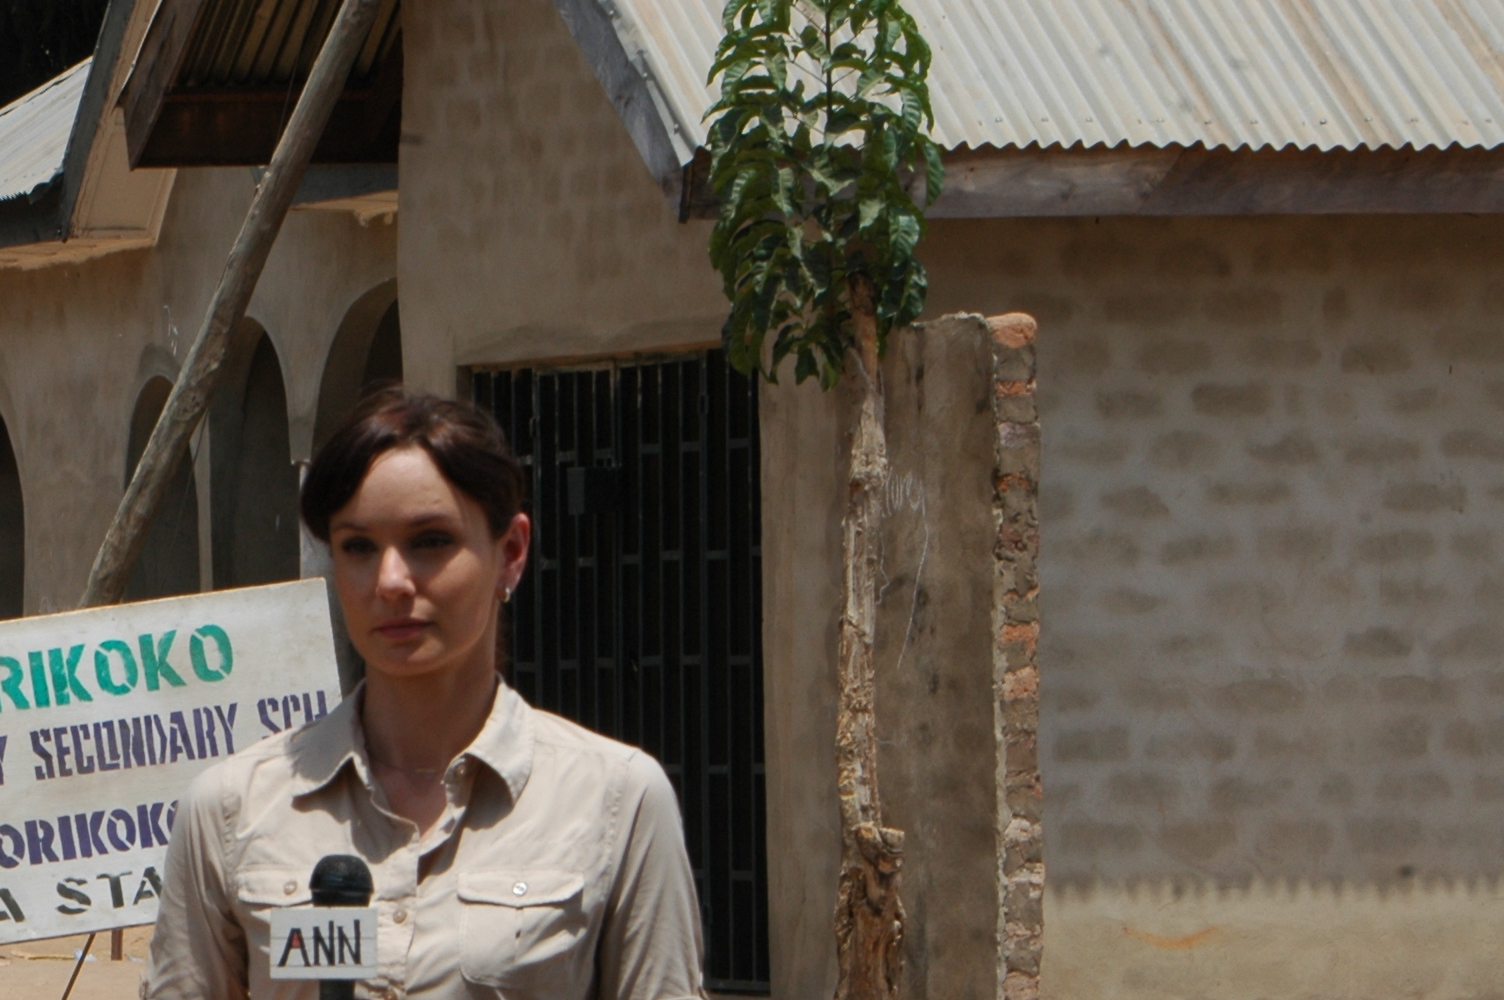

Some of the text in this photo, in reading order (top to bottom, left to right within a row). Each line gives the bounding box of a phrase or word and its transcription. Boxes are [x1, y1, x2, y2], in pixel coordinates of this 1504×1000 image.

[29, 702, 238, 781] SECONDARY
[56, 866, 163, 916] STA
[276, 918, 363, 969] ANN
